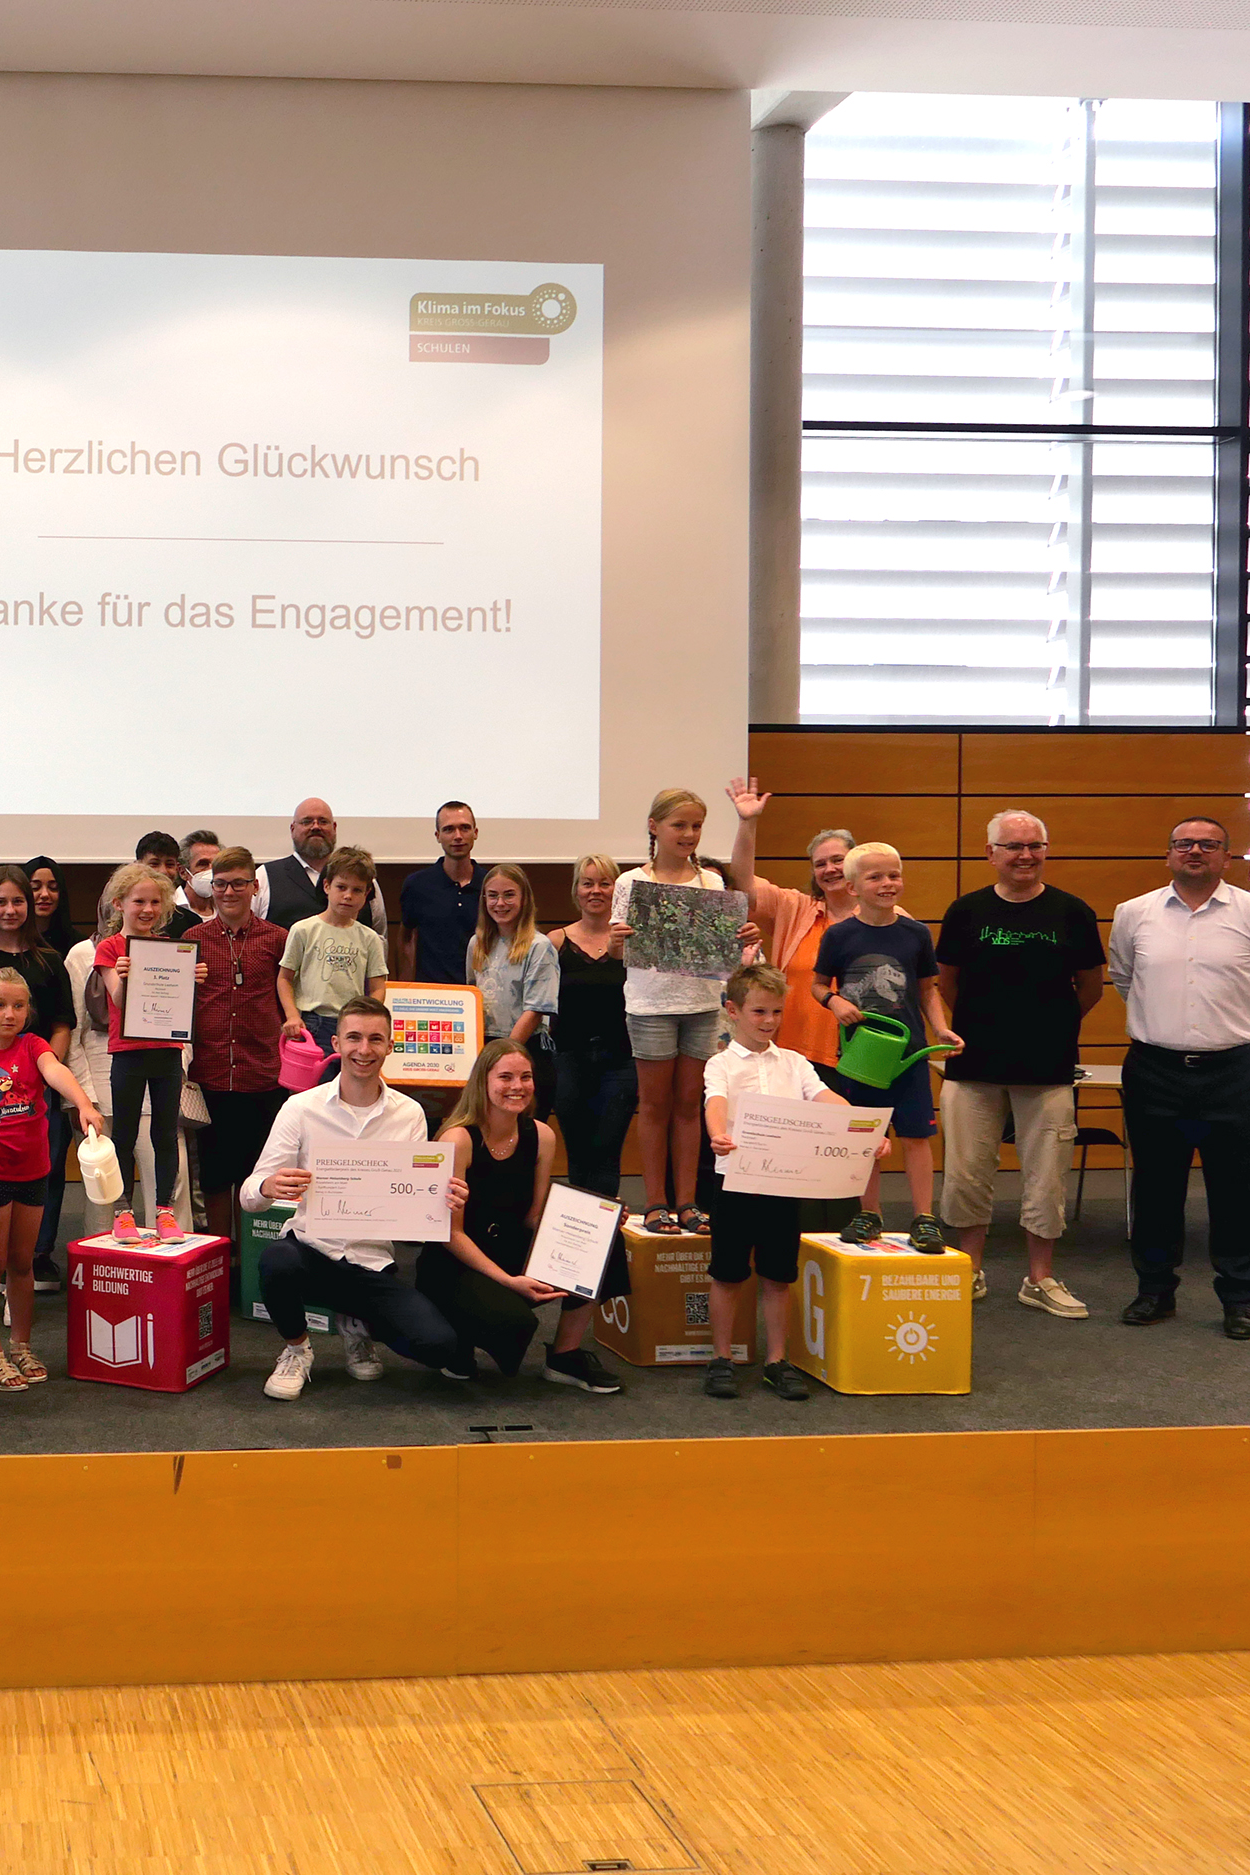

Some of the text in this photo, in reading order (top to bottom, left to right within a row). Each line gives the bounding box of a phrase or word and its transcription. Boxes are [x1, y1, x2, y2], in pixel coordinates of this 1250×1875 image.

[417, 300, 526, 316] Klima im Fokus
[417, 317, 510, 328] KREIS GROSS-GERAU
[417, 343, 470, 353] SCHULEN
[217, 442, 480, 482] Glückwunsch
[97, 592, 151, 628] für
[163, 593, 236, 629] das
[251, 594, 512, 639] Engagement!
[412, 998, 464, 1007] ENTWICKLUNG
[743, 1113, 823, 1129] PREISGELDSCHECK
[862, 1147, 874, 1158] €
[316, 1158, 389, 1167] PREISGELDSCHECK
[428, 1183, 438, 1194] €
[253, 1219, 268, 1229] MEHR
[560, 1213, 599, 1229] AUSZEICHNUNG
[252, 1229, 279, 1240] NACHHALT
[656, 1252, 675, 1261] MEHR
[675, 1251, 693, 1261] ÜBER
[92, 1264, 154, 1284] HOCHWERTIGE
[654, 1263, 699, 1273] NACHHALTIGE
[71, 1263, 84, 1290] 4
[882, 1274, 961, 1286] BEZAHLBARE UND
[92, 1280, 129, 1296] BILDUNG
[859, 1274, 872, 1302] 7
[882, 1289, 961, 1301] SAUBERE ENERGIE
[803, 1259, 825, 1360] G
